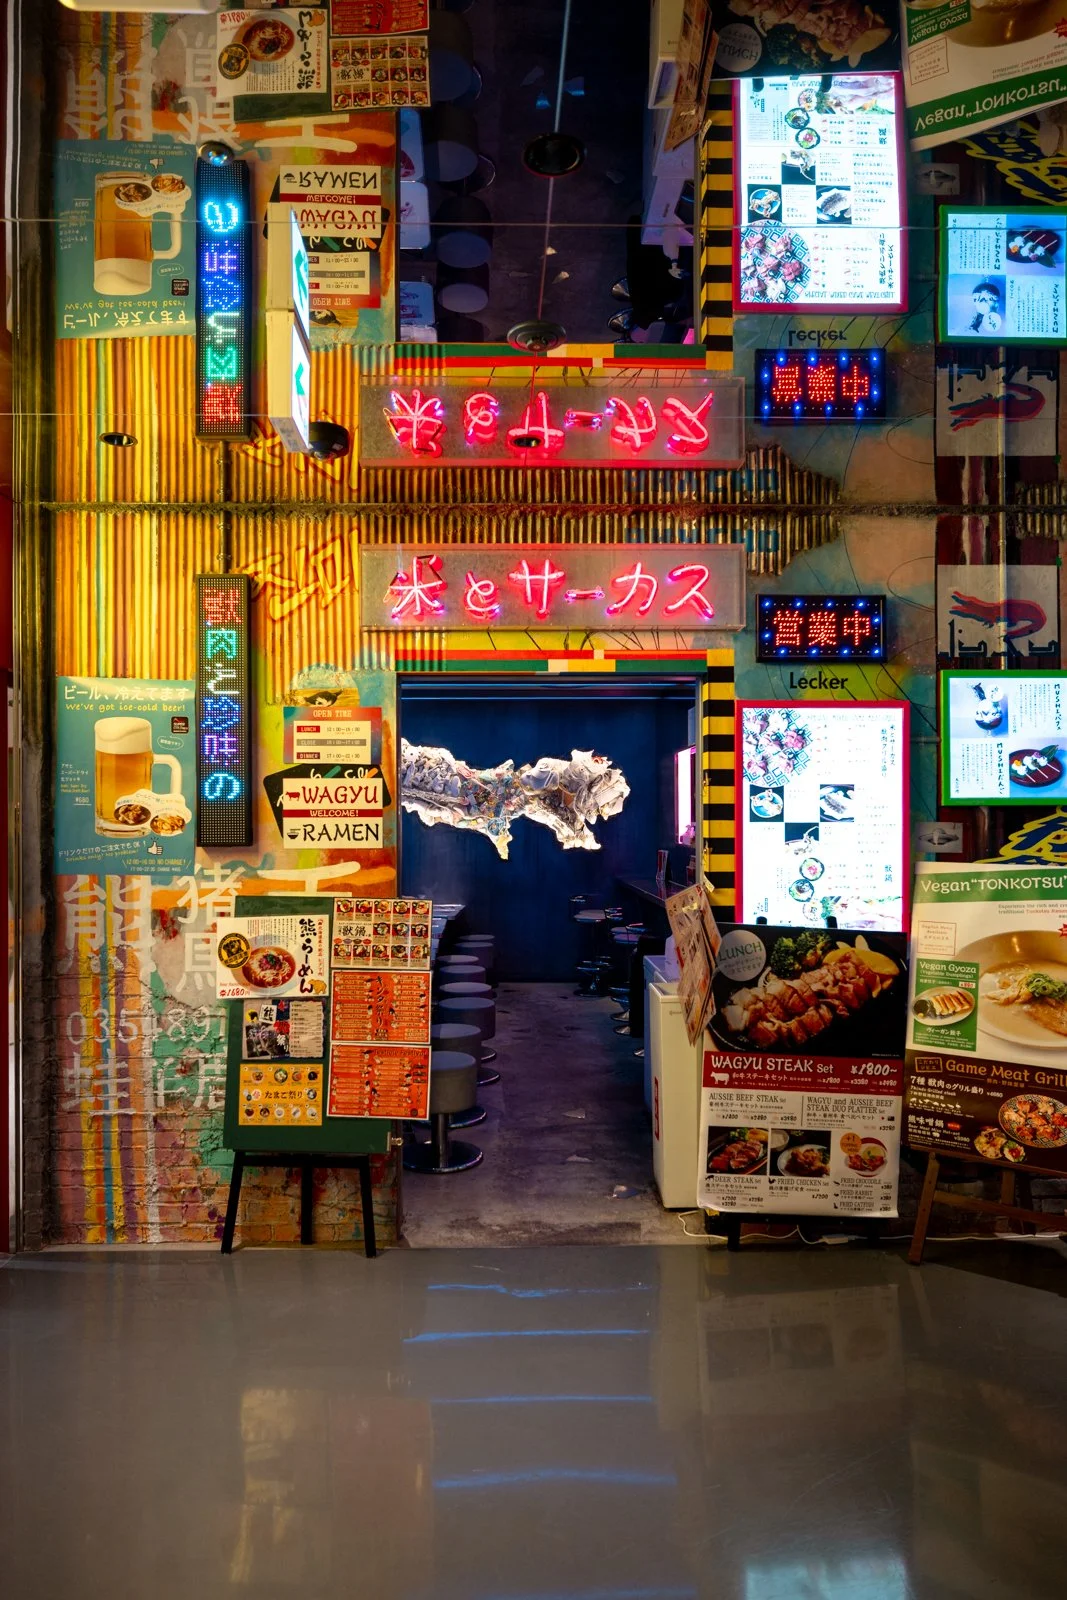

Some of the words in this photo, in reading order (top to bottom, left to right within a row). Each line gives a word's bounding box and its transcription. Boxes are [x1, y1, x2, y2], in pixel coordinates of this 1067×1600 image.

[383, 553, 716, 619] 米とサーカス
[773, 610, 871, 648] 営業中
[788, 671, 849, 691] Lecker
[64, 684, 190, 702] ビール、冷えてます
[98, 703, 115, 713] got
[162, 703, 186, 712] beer!
[313, 709, 332, 718] OPEN
[334, 709, 352, 718] TIME
[302, 785, 379, 804] WAGYU
[309, 809, 360, 817] WELCOME!
[302, 823, 380, 843] RAMEN
[920, 879, 971, 895] Vegan
[298, 918, 317, 994] 熊らーめん
[718, 940, 763, 962] LUNCH
[920, 961, 947, 976] Vegan
[948, 963, 977, 979] Gyoza
[711, 1055, 763, 1071] WAGYU
[767, 1057, 814, 1073] STEAK
[816, 1063, 834, 1074] Set
[945, 1059, 988, 1076] Game
[991, 1065, 1030, 1082] Meat
[733, 1071, 787, 1082] 和牛ステーキセット
[265, 1091, 303, 1100] たまご祭り
[709, 1093, 734, 1101] AUSSIE
[736, 1093, 754, 1102] BEEF
[756, 1095, 779, 1103] STEAK
[807, 1096, 832, 1104] WAGYU
[833, 1097, 847, 1105] and
[849, 1098, 874, 1106] AUSSIE
[876, 1099, 895, 1107] BEEF
[806, 1103, 830, 1111] STEAK
[832, 1104, 848, 1112] DUO
[848, 1106, 878, 1114] PLATTER
[733, 1177, 755, 1185] STEAK
[777, 1178, 795, 1186] FRIED
[796, 1179, 822, 1187] CHICKEN
